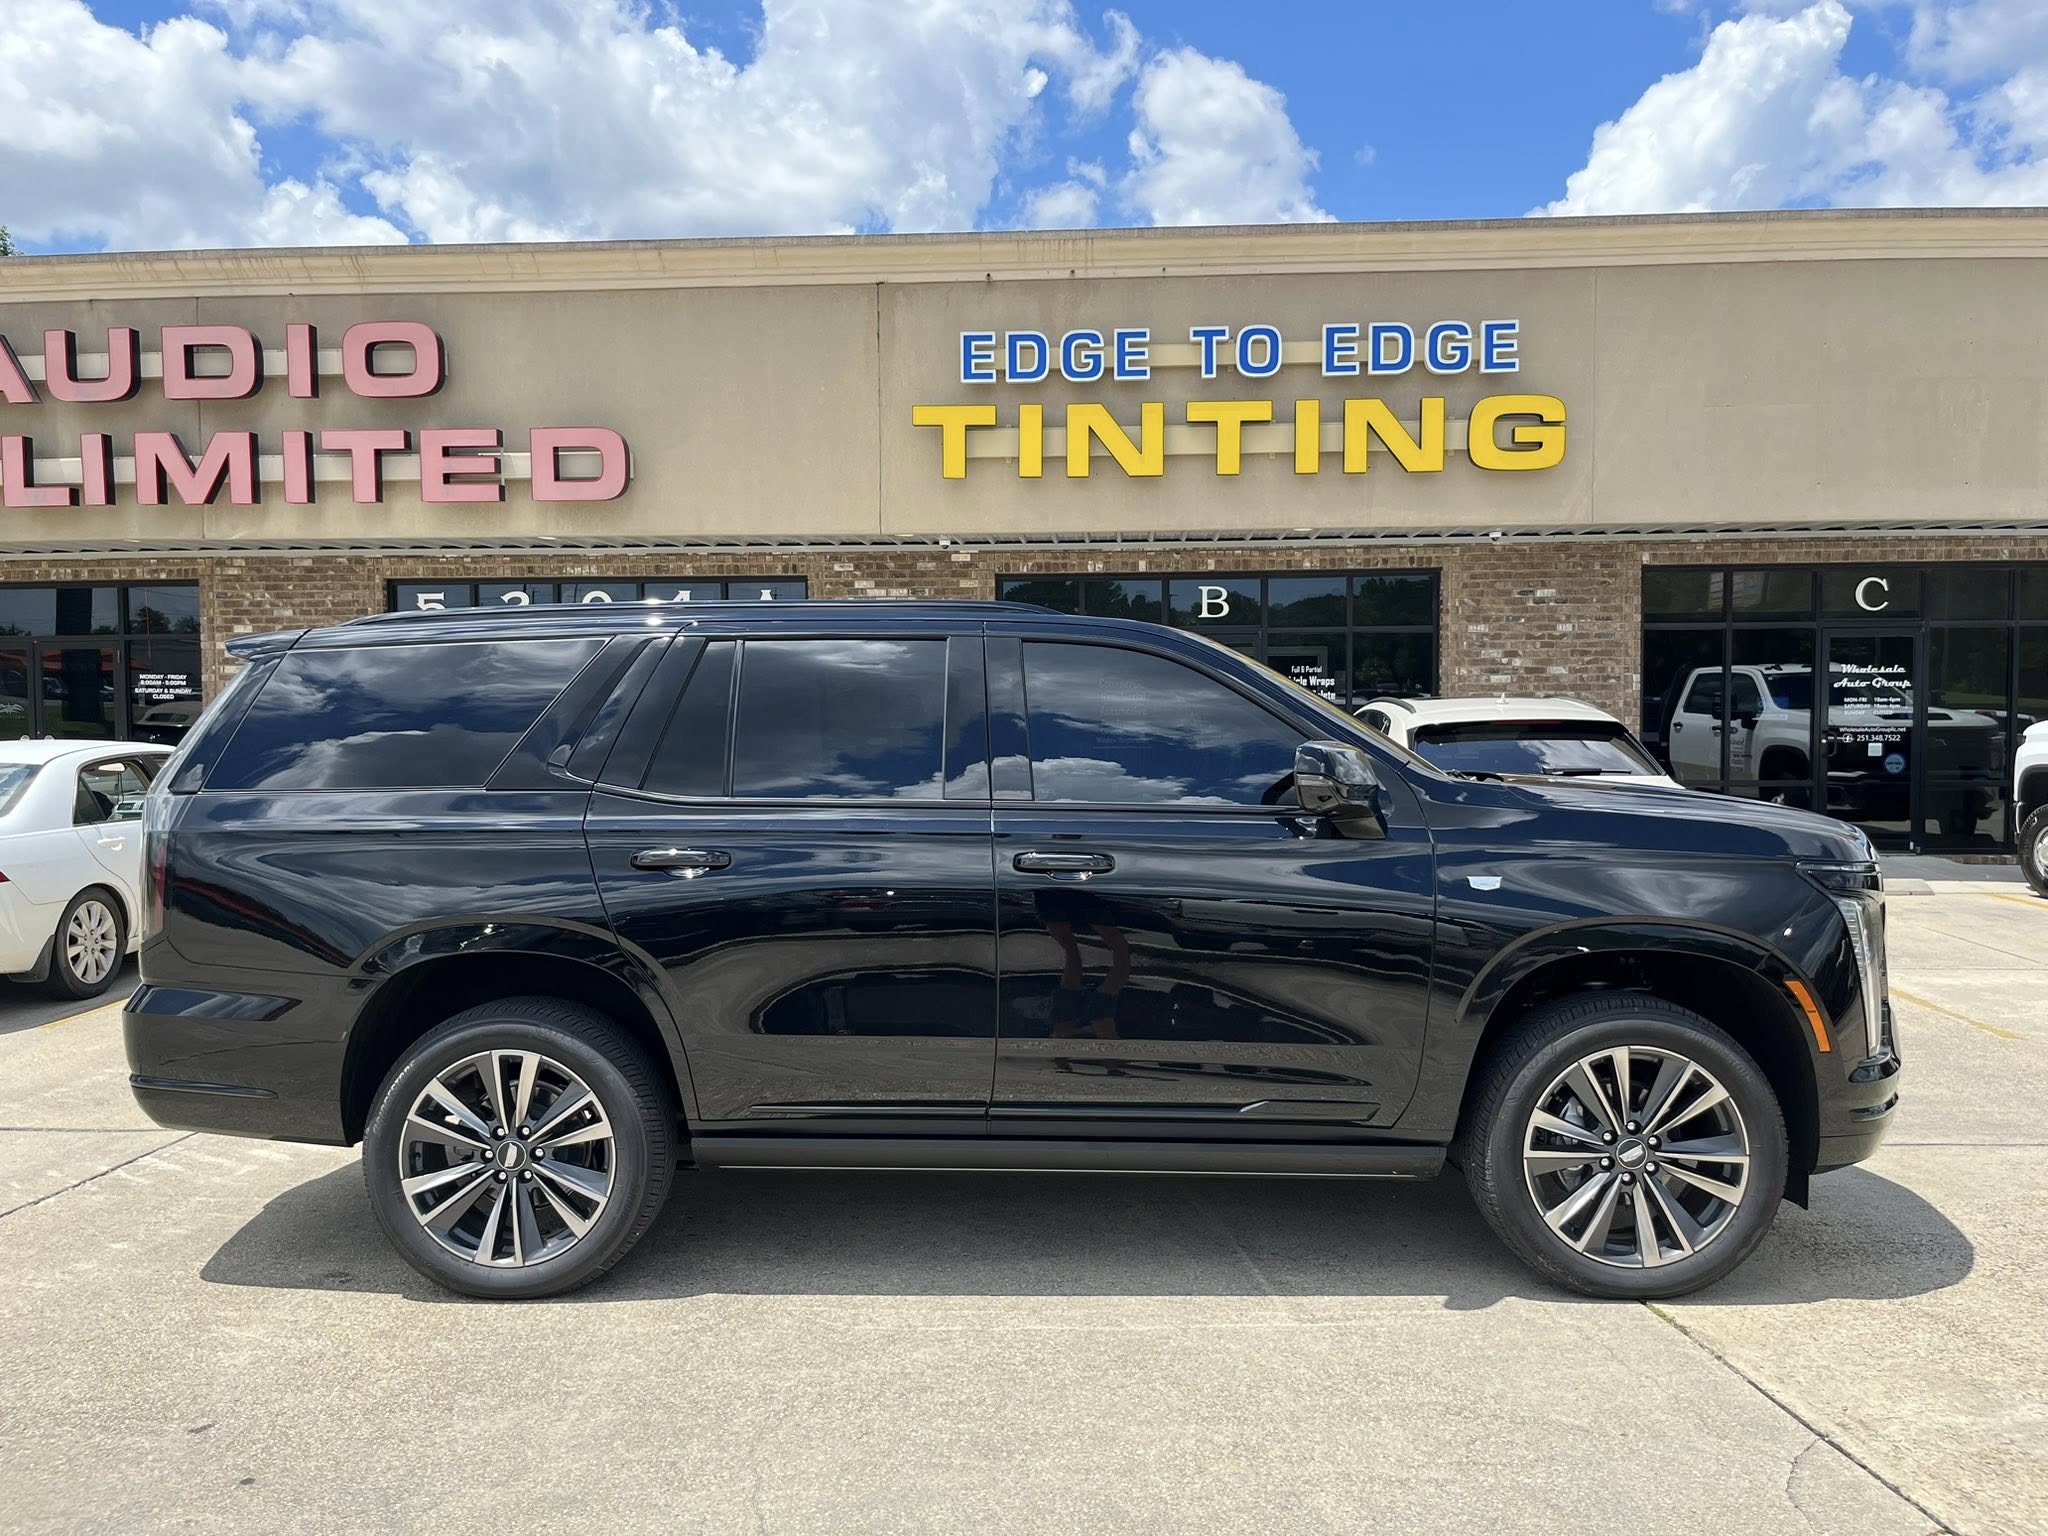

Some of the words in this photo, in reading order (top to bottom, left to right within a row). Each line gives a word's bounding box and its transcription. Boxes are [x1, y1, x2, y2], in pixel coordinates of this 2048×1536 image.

[959, 327, 1151, 384] EDGE
[1190, 323, 1283, 380] TO
[1321, 318, 1520, 378] EDGE
[911, 393, 1568, 479] TINTING
[1, 426, 632, 507] LIMITED
[1198, 585, 1230, 618] B
[1854, 576, 1889, 612] C
[1305, 665, 1323, 673] Partial
[1840, 664, 1906, 674] Wholesale
[1309, 675, 1336, 688] Wraps
[1833, 677, 1871, 688] Auto
[1871, 677, 1912, 688] Group
[1856, 734, 1901, 742] 251.348.7522
